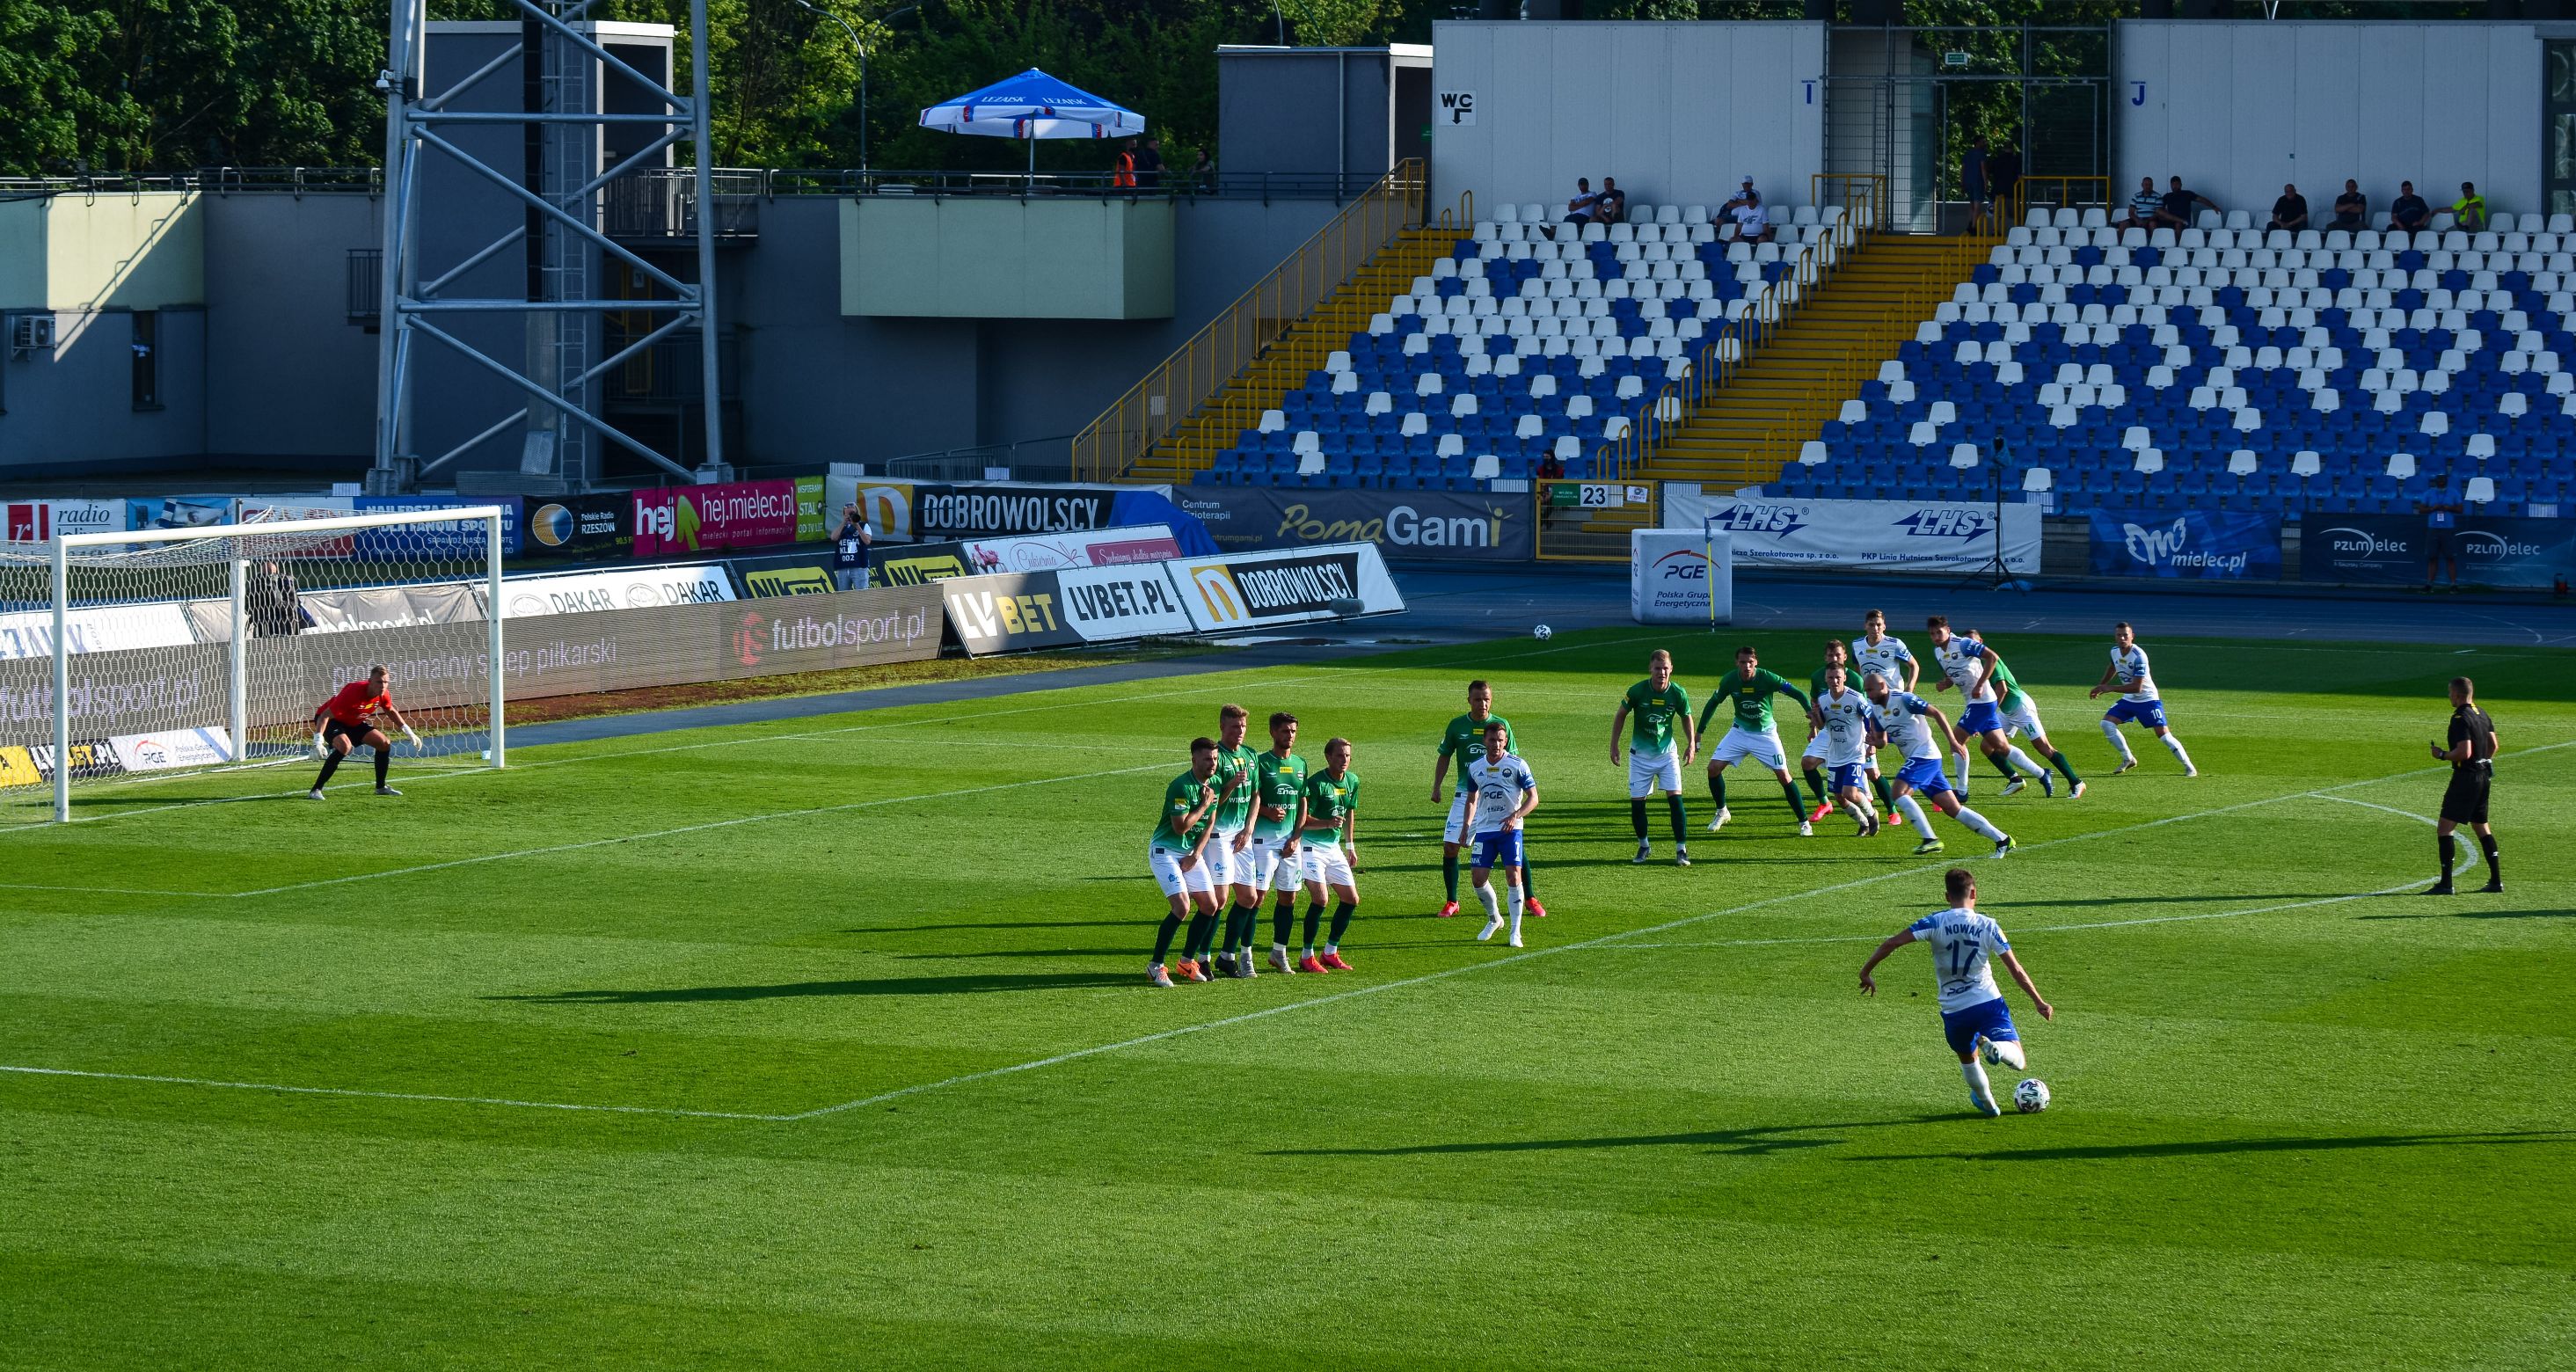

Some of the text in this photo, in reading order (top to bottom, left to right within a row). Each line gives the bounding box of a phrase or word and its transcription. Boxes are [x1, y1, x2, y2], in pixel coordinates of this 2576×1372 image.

[1441, 93, 1473, 107] WC
[2132, 84, 2145, 106] J
[1583, 487, 1606, 505] 23
[702, 486, 795, 528] hej.mielec.pl
[799, 502, 817, 515] STAL
[1182, 500, 1220, 509] Centrum
[57, 504, 110, 523] radio
[924, 494, 1099, 531] DOBROWOLSCY
[1733, 505, 1796, 531] LHS
[462, 520, 514, 531] SPOTU
[581, 520, 616, 534] RZESZÓW
[636, 499, 675, 542] hej
[1915, 509, 1980, 536] LHS
[732, 529, 753, 539] portal
[1212, 534, 1263, 543] ntrumgami.pl
[1749, 549, 1805, 558] Szerokotorowa
[1935, 554, 1990, 563] Szerokotorowa
[2171, 551, 2247, 572] mielec.pl
[1663, 565, 1707, 580] PGE
[662, 580, 725, 604] DAKAR
[1237, 563, 1354, 609] DOBROWOLSCY
[550, 588, 617, 614] DAKAR
[1068, 579, 1176, 622] LVBET.PL
[1657, 590, 1684, 599] Polska
[1654, 600, 1710, 609] Energetyczna
[951, 590, 1057, 639] LVBET
[771, 606, 925, 652] futbolsport.pl
[332, 636, 617, 696] profsjonalny sep piłkarski
[2150, 708, 2163, 719] 10
[2024, 723, 2036, 737] 14
[29, 741, 120, 771] LVET.PL
[175, 745, 193, 754] Polska
[144, 752, 167, 764] PGE
[1771, 753, 1784, 766] 10
[1851, 764, 1862, 777] 20
[1484, 792, 1503, 800] PGE
[1945, 923, 1983, 938] NOWAK
[1945, 939, 1981, 977] 17
